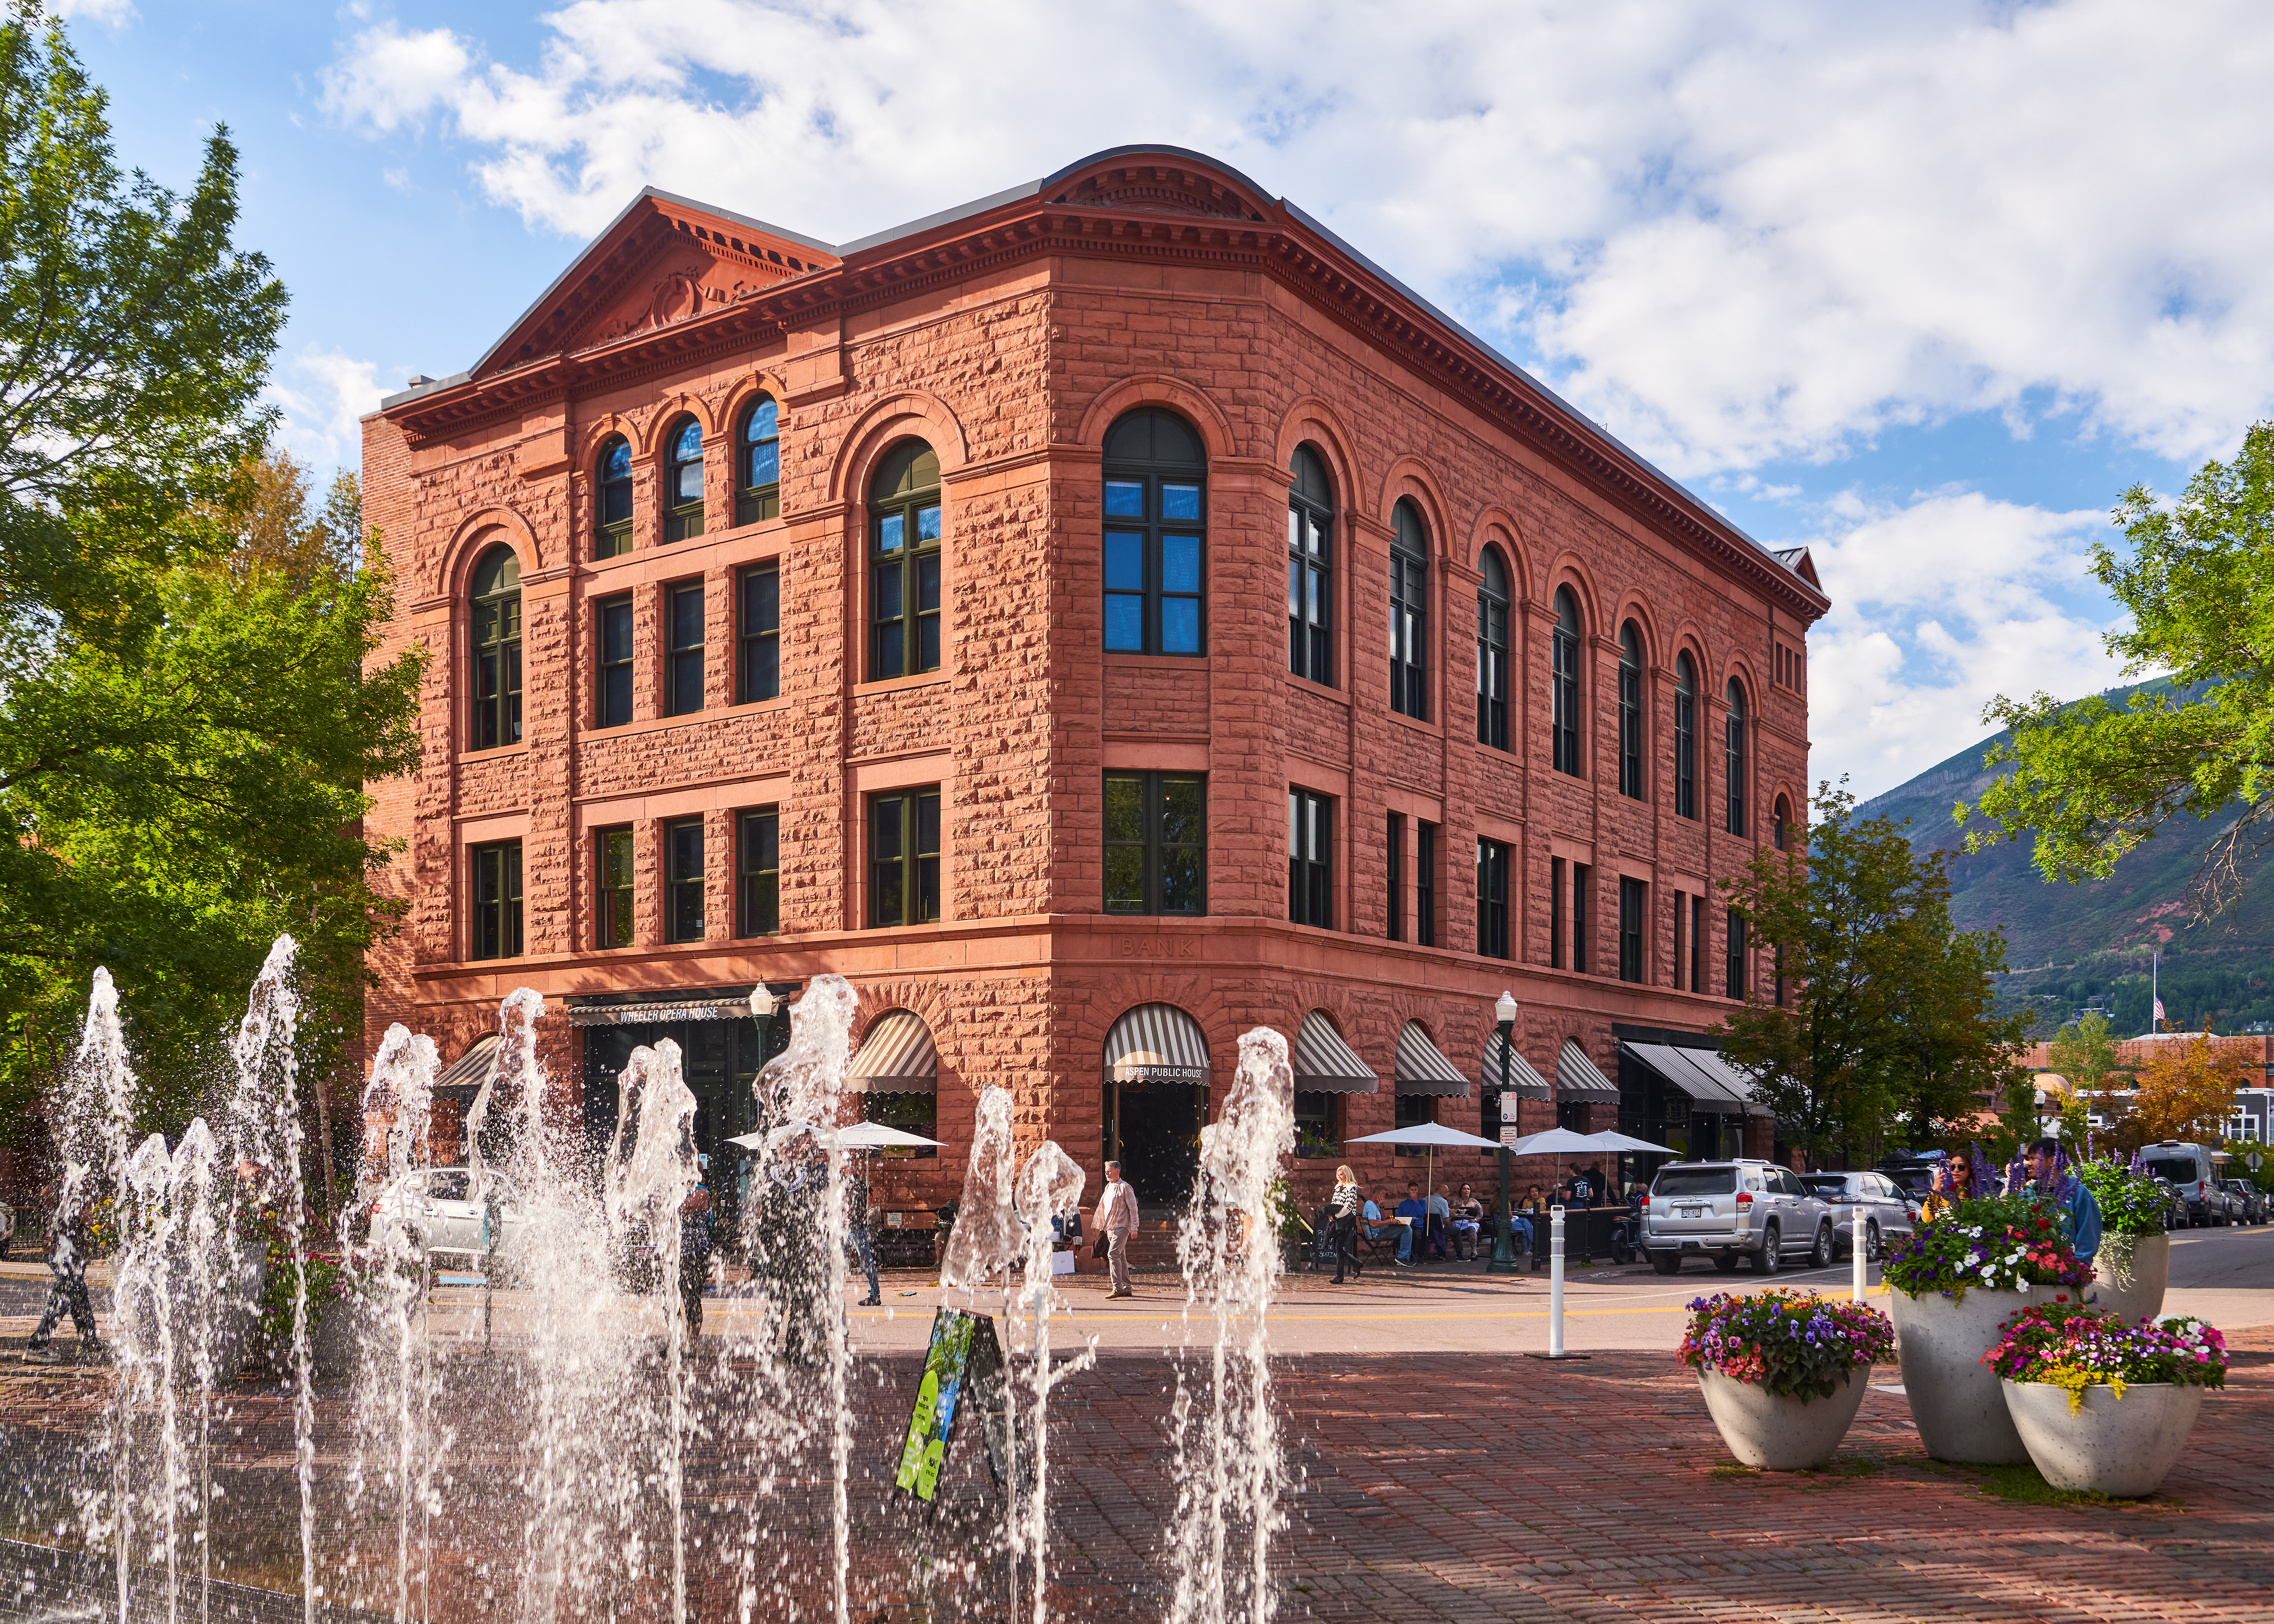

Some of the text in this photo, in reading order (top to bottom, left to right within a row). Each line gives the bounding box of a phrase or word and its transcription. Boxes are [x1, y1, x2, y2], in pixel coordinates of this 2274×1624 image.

[1121, 938, 1194, 956] BANK
[621, 1006, 718, 1022] WHEELER OPERA HOUSE
[1125, 1067, 1202, 1078] ASPEN PUBLIC HOUSE
